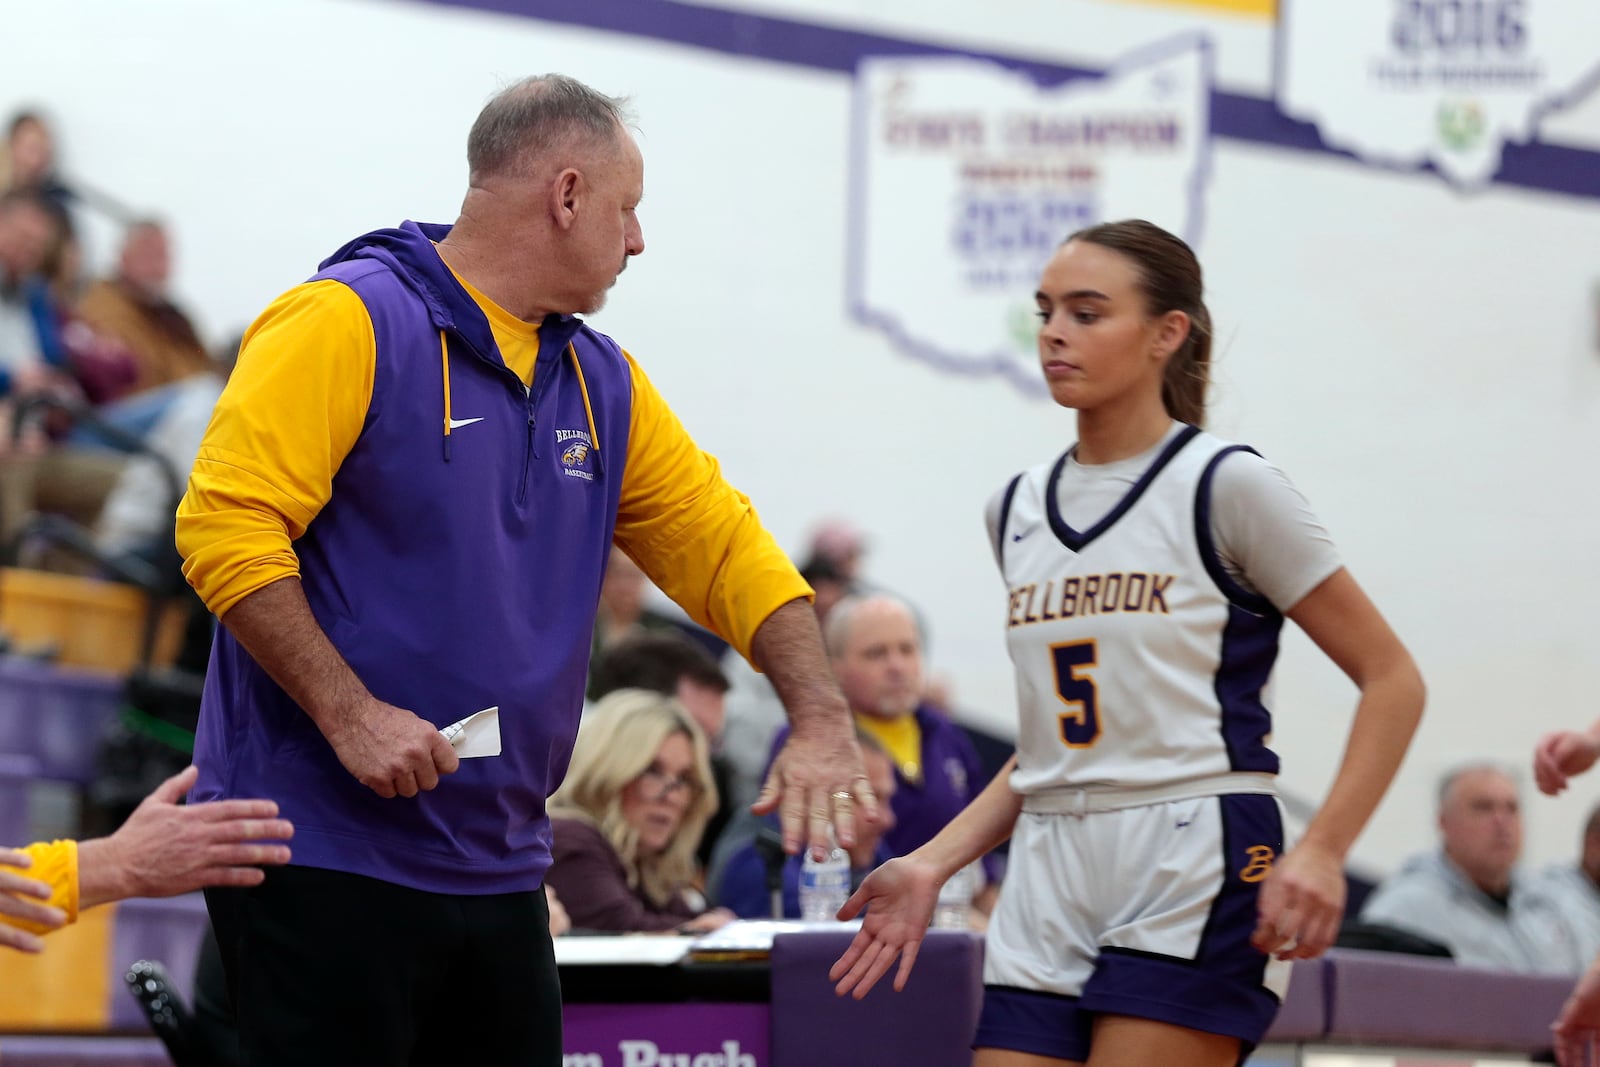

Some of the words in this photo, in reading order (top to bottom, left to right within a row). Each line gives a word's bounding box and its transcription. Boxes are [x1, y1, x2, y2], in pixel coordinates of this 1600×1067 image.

[884, 112, 986, 150] STATE
[1002, 113, 1181, 151] CHAMPION
[555, 429, 594, 448] BELLBROO
[1008, 572, 1176, 629] ELLBROOK
[1048, 637, 1102, 749] 5
[1239, 844, 1276, 884] B
